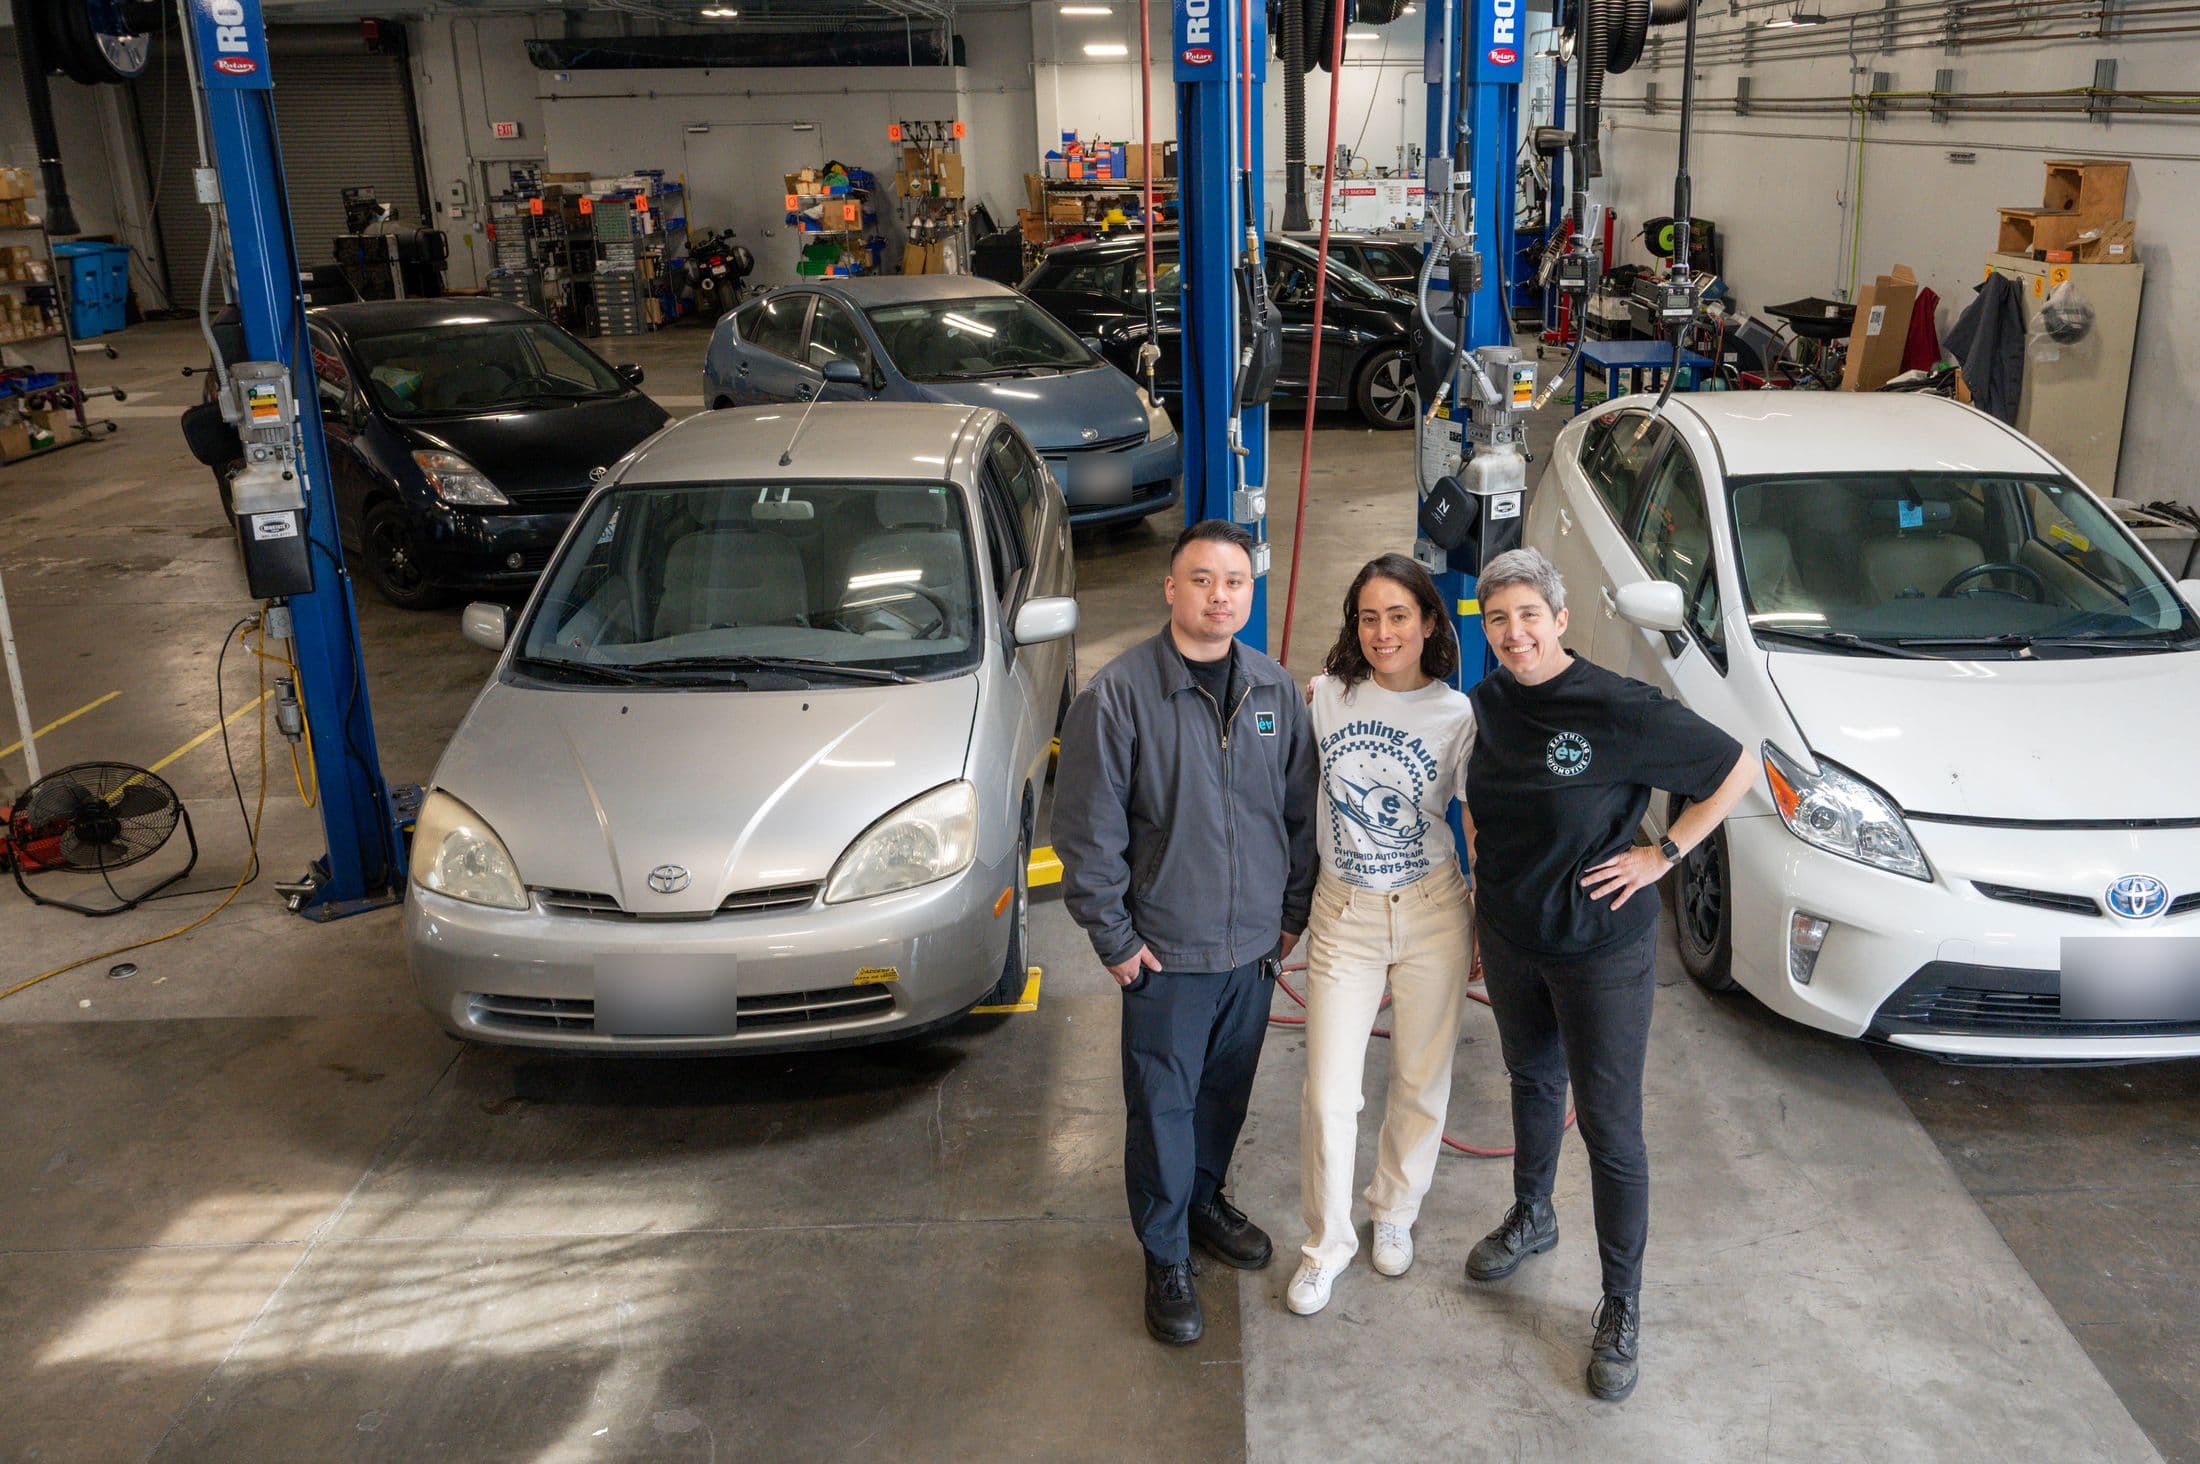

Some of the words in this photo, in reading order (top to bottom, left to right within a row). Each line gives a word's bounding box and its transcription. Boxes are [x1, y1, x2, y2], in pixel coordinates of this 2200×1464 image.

[1185, 51, 1213, 64] Rotary
[1490, 51, 1515, 64] Rotary
[217, 59, 256, 73] Rotary
[497, 123, 513, 137] EXIT
[1319, 719, 1409, 754] Earthling
[1405, 737, 1438, 783] Auto
[1547, 754, 1588, 775] AUTOMOTIVE
[1343, 849, 1373, 861] HYBRID
[1374, 851, 1398, 860] AUTO
[1334, 856, 1355, 870] Call
